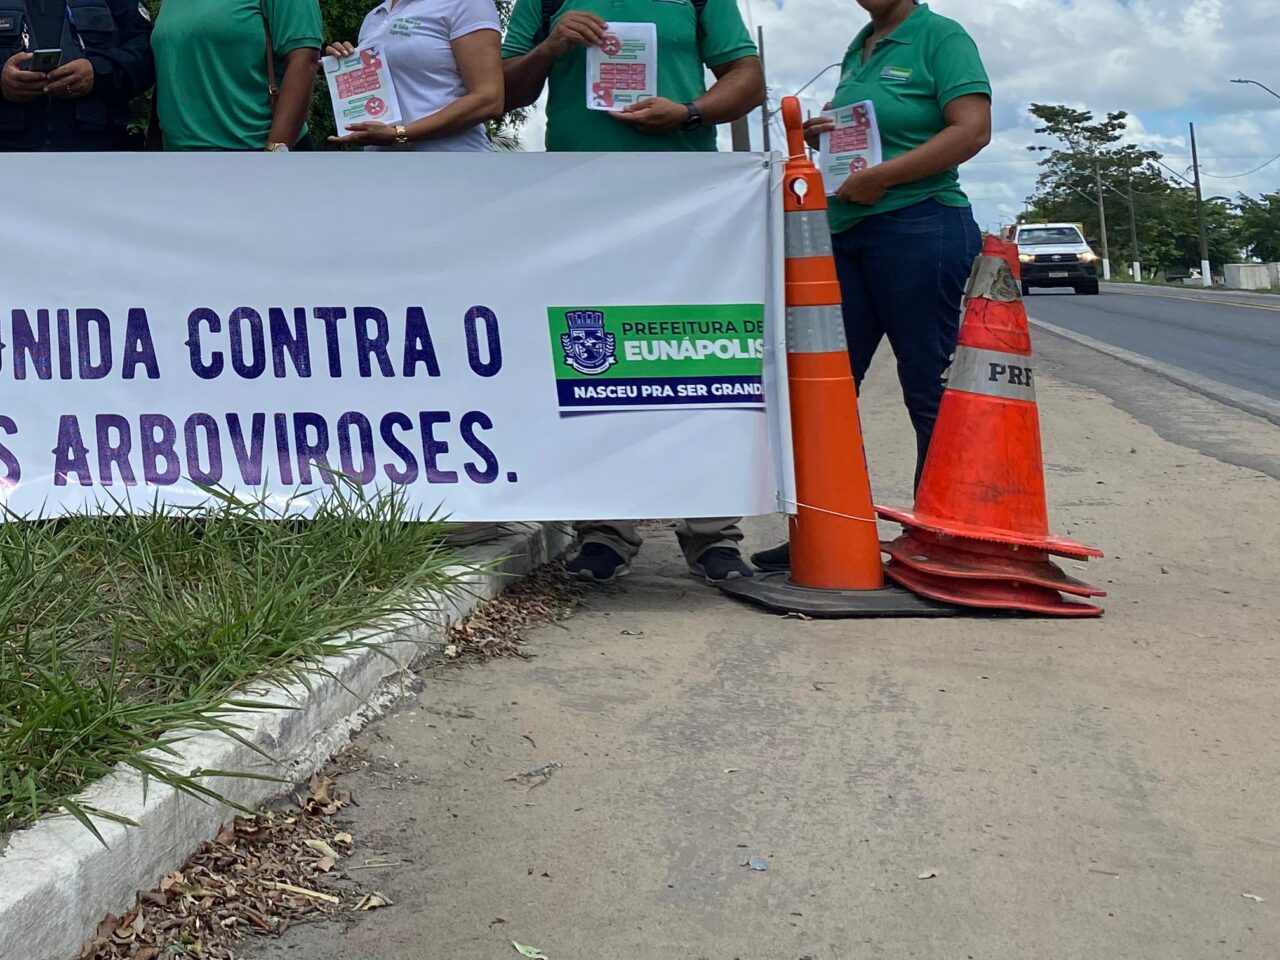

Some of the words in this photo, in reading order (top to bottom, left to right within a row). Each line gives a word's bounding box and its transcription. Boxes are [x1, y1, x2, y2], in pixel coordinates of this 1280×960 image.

[622, 320, 738, 335] PREFEITURA
[743, 319, 764, 334] DE
[184, 306, 441, 379] CONTRA
[463, 305, 503, 377] O
[624, 336, 764, 362] EUNÁPOLIS
[988, 362, 1033, 387] PRF
[573, 385, 638, 399] NASCEU
[641, 385, 674, 398] PRA
[677, 383, 708, 397] SER
[711, 382, 764, 396] GRAND
[51, 410, 518, 487] ARBOVIROSES.
